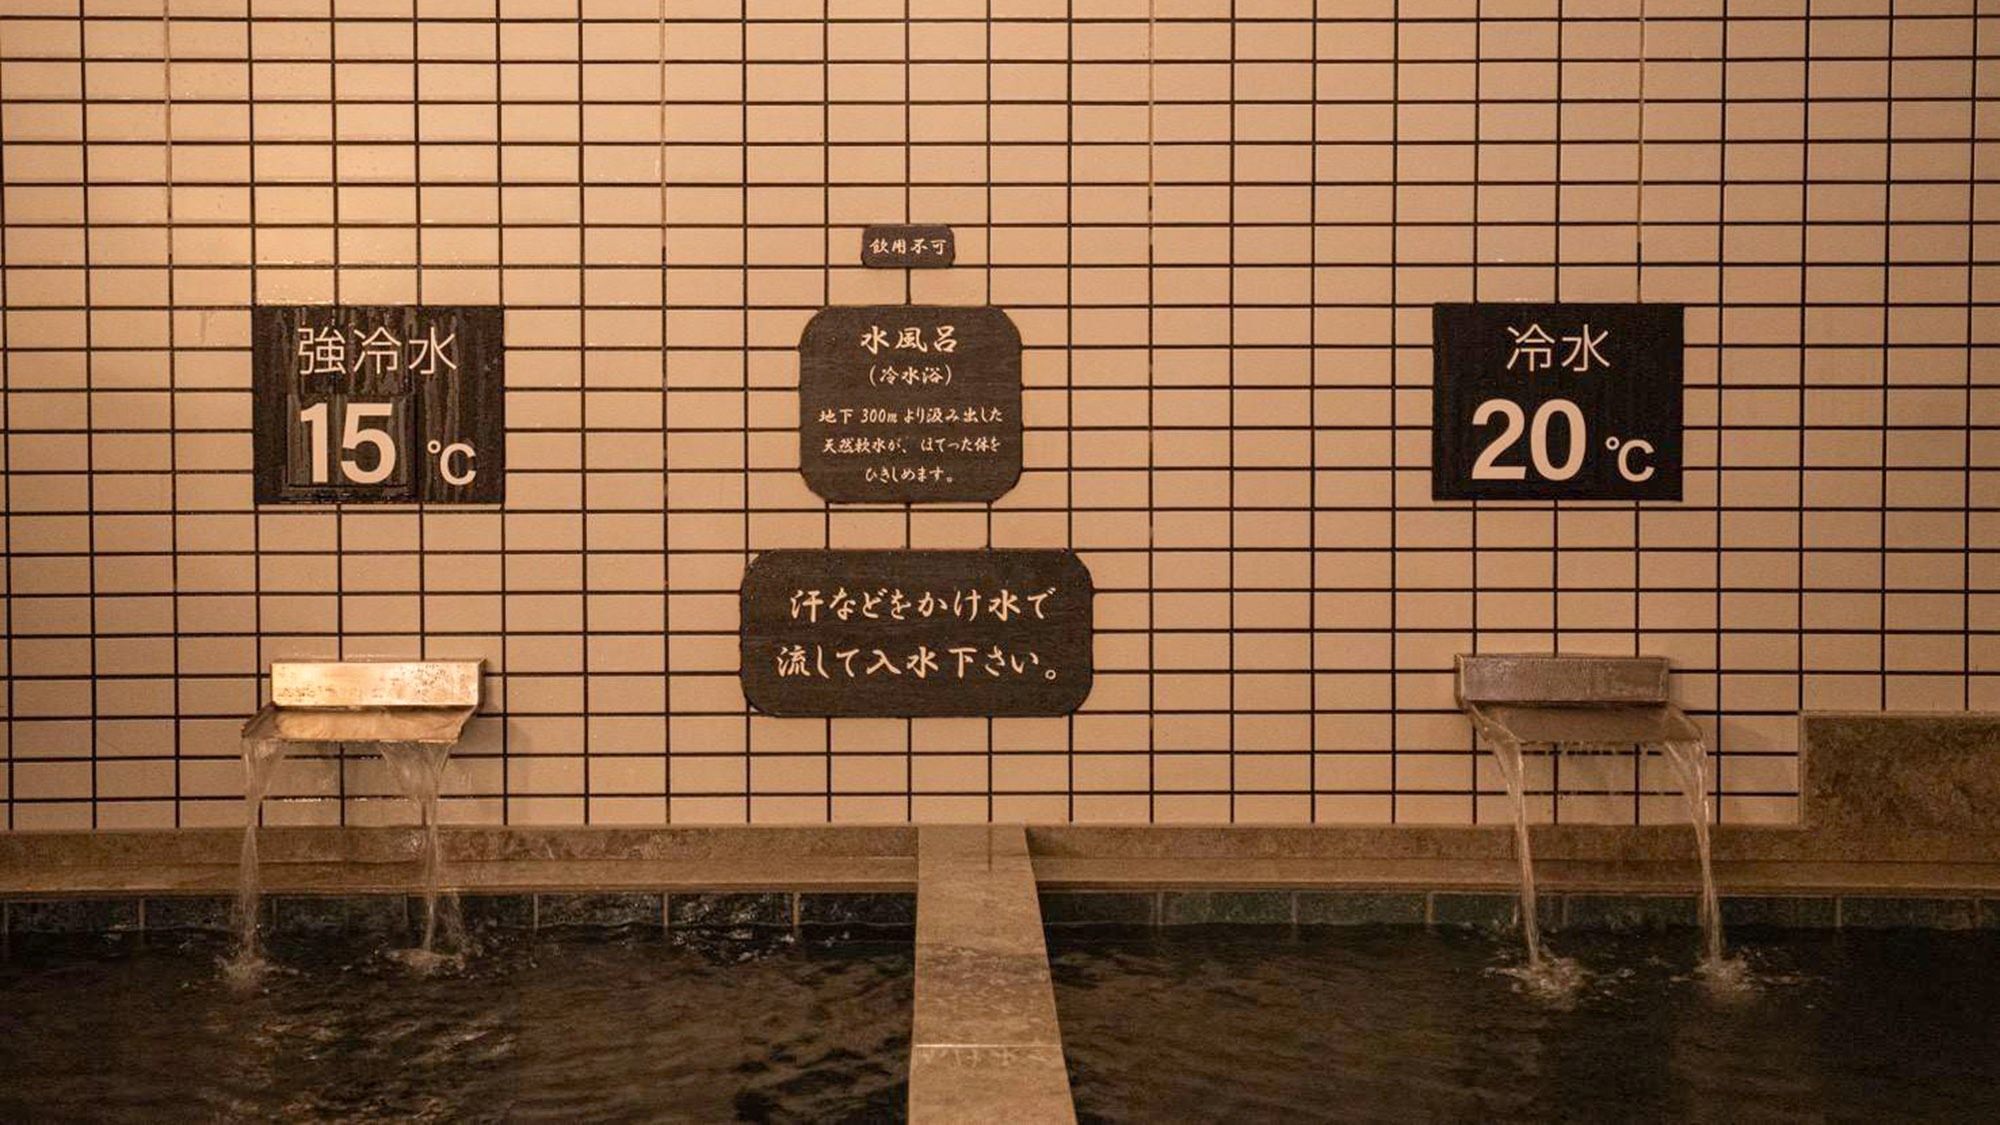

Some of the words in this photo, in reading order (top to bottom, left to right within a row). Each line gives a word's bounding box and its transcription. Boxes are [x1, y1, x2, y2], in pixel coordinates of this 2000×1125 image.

[869, 237, 947, 256] 飲用不可
[298, 326, 458, 375] 強冷水
[861, 325, 958, 355] 水風呂
[1506, 323, 1611, 373] 冷水
[869, 364, 953, 387] （冷水浴）
[300, 402, 396, 484] 15
[1471, 398, 1587, 482] 20
[865, 465, 953, 484] ひきしめます。
[790, 587, 1057, 623] 汗などをかけ水で
[776, 645, 1057, 680] 流して入水下さい。
